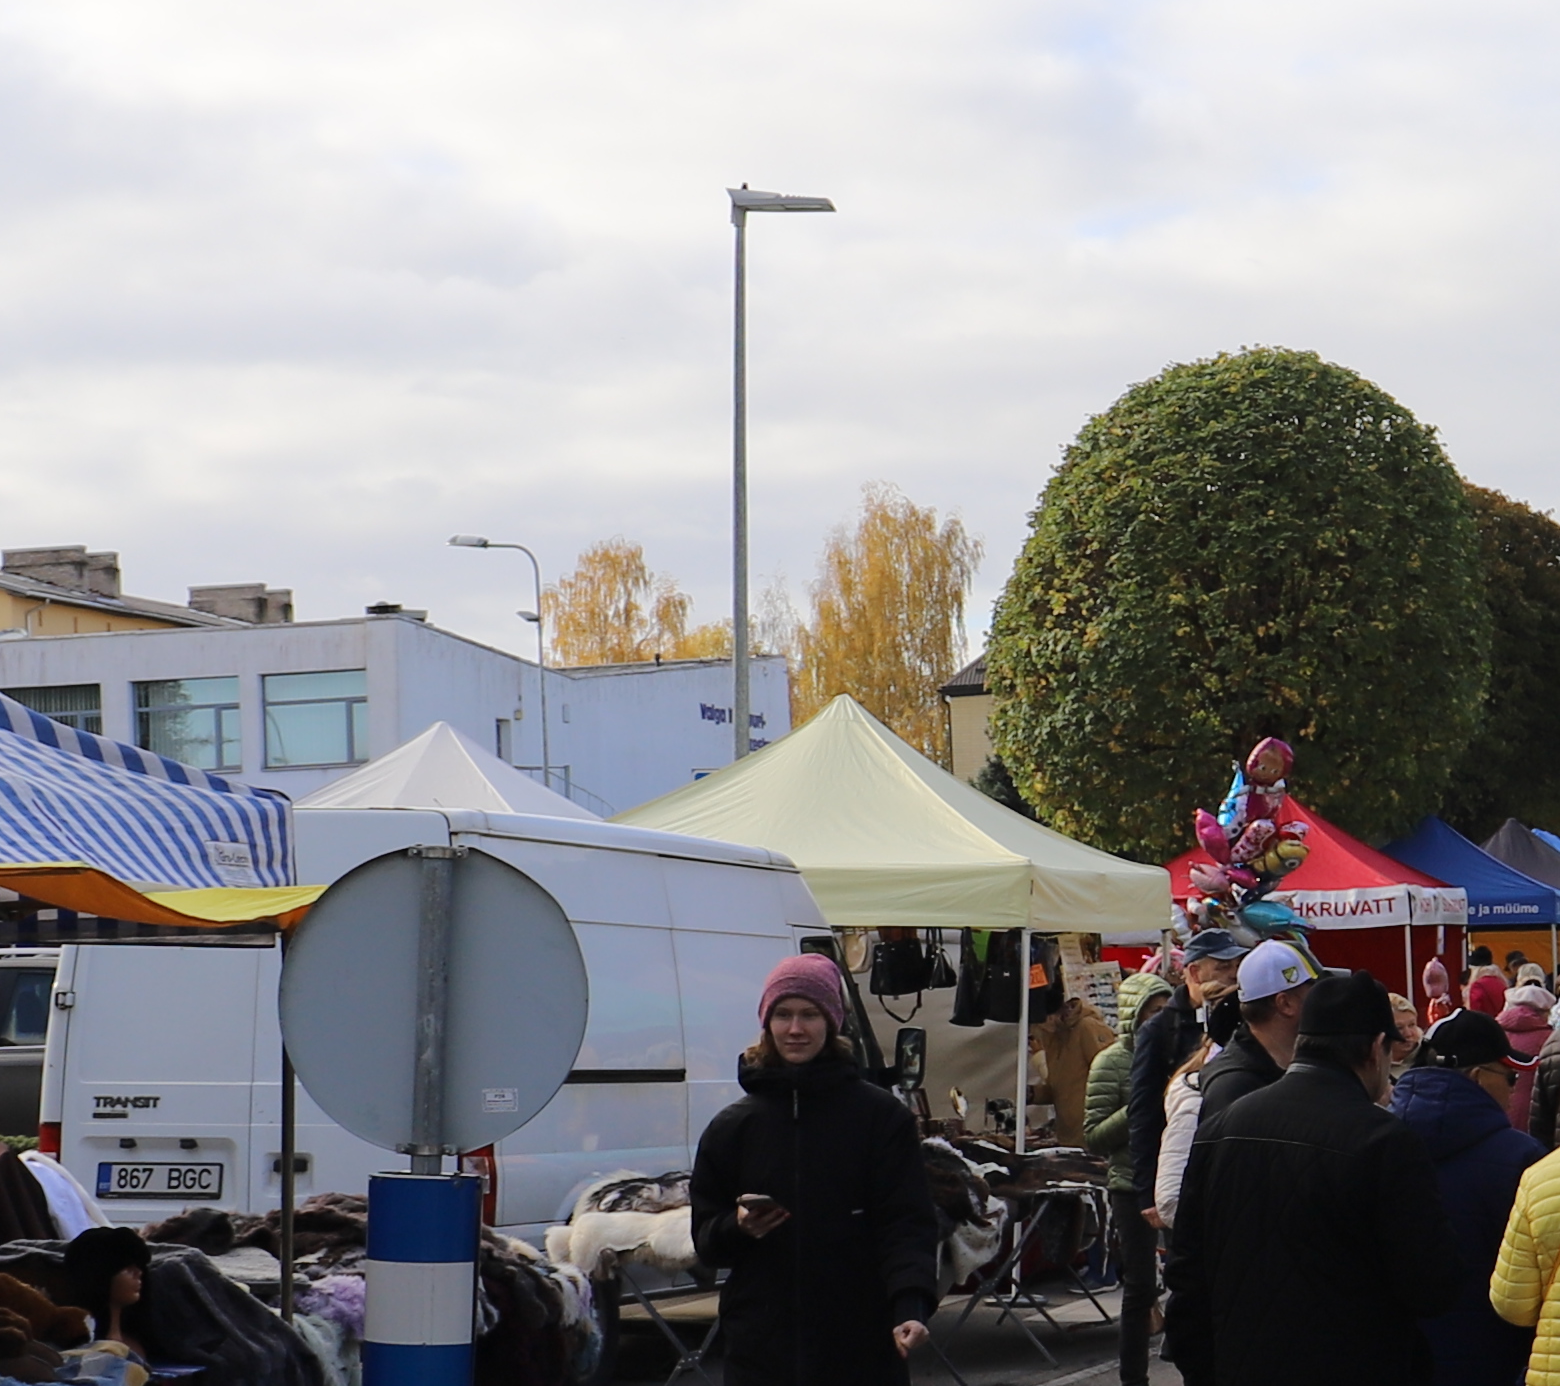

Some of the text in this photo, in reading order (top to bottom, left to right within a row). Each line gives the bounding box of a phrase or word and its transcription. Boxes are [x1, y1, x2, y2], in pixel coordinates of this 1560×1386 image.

[699, 702, 727, 725] Valga
[1292, 897, 1396, 917] HKRUVATT
[1478, 904, 1490, 917] ja
[1493, 903, 1539, 915] müüme
[93, 1095, 161, 1109] TRANSIT
[117, 1167, 212, 1190] 867 BGC
